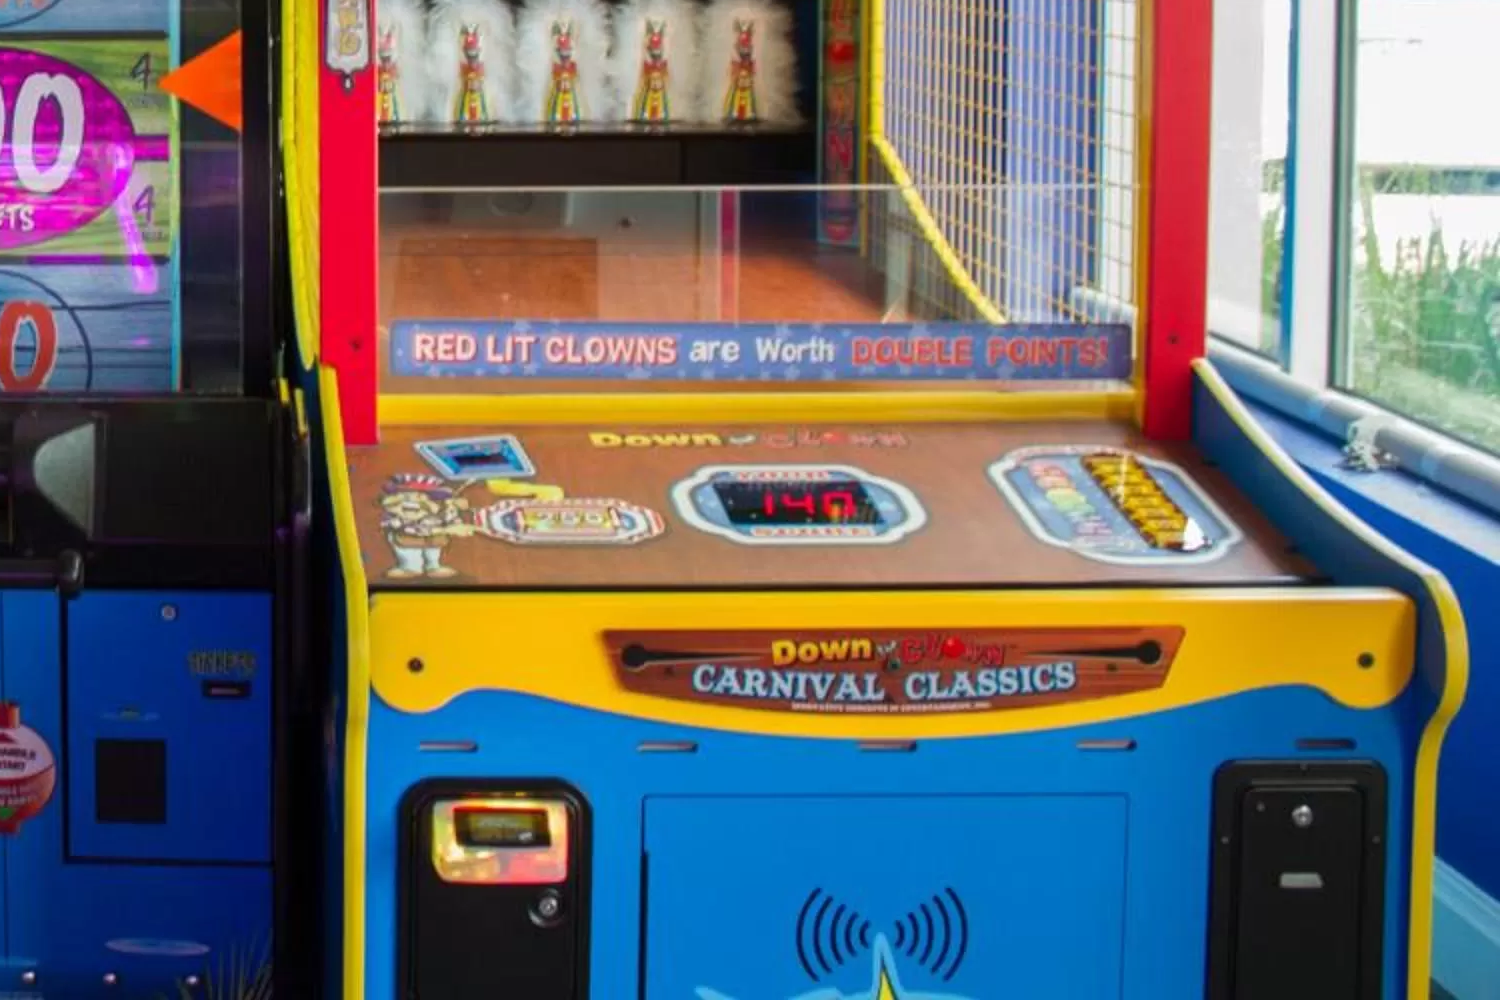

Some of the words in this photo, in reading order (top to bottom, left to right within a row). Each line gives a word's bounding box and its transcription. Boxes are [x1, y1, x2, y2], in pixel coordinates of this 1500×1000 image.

[131, 52, 151, 90] 4
[133, 184, 155, 222] 4
[413, 332, 477, 363] RED
[486, 333, 537, 364] LIT
[544, 334, 678, 367] CLOWNS
[688, 339, 741, 364] are
[754, 335, 835, 364] Worth
[851, 335, 974, 367] DOUBLE
[987, 336, 1110, 368] POINTS!
[692, 664, 885, 701] CARNIVAL
[904, 662, 1076, 700] CLASSICS
